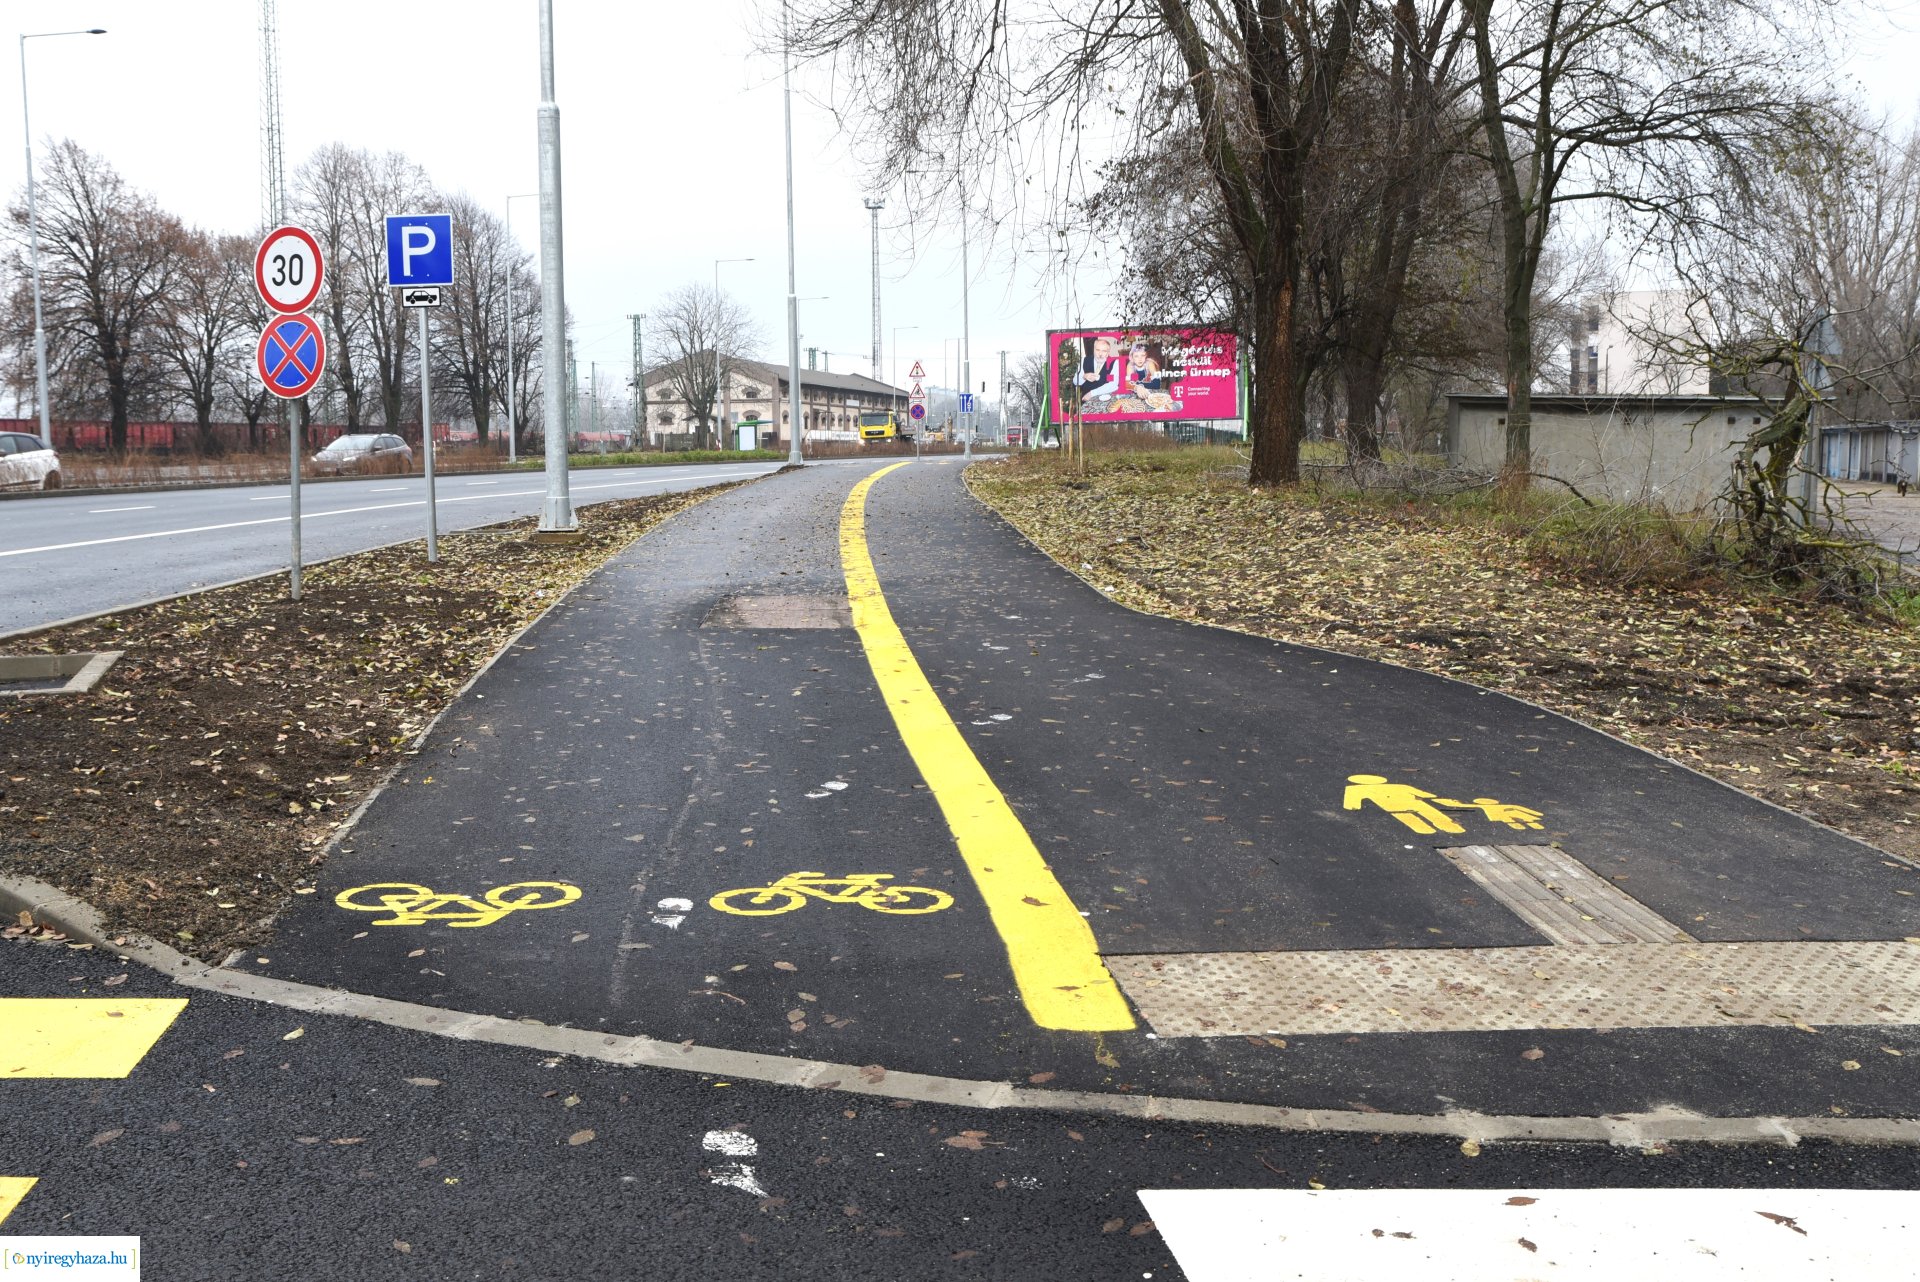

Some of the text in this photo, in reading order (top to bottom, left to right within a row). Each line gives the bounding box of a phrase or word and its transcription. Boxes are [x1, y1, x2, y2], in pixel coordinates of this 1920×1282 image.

[401, 225, 437, 277] P
[271, 253, 304, 287] 30
[1189, 367, 1231, 378] ünnep
